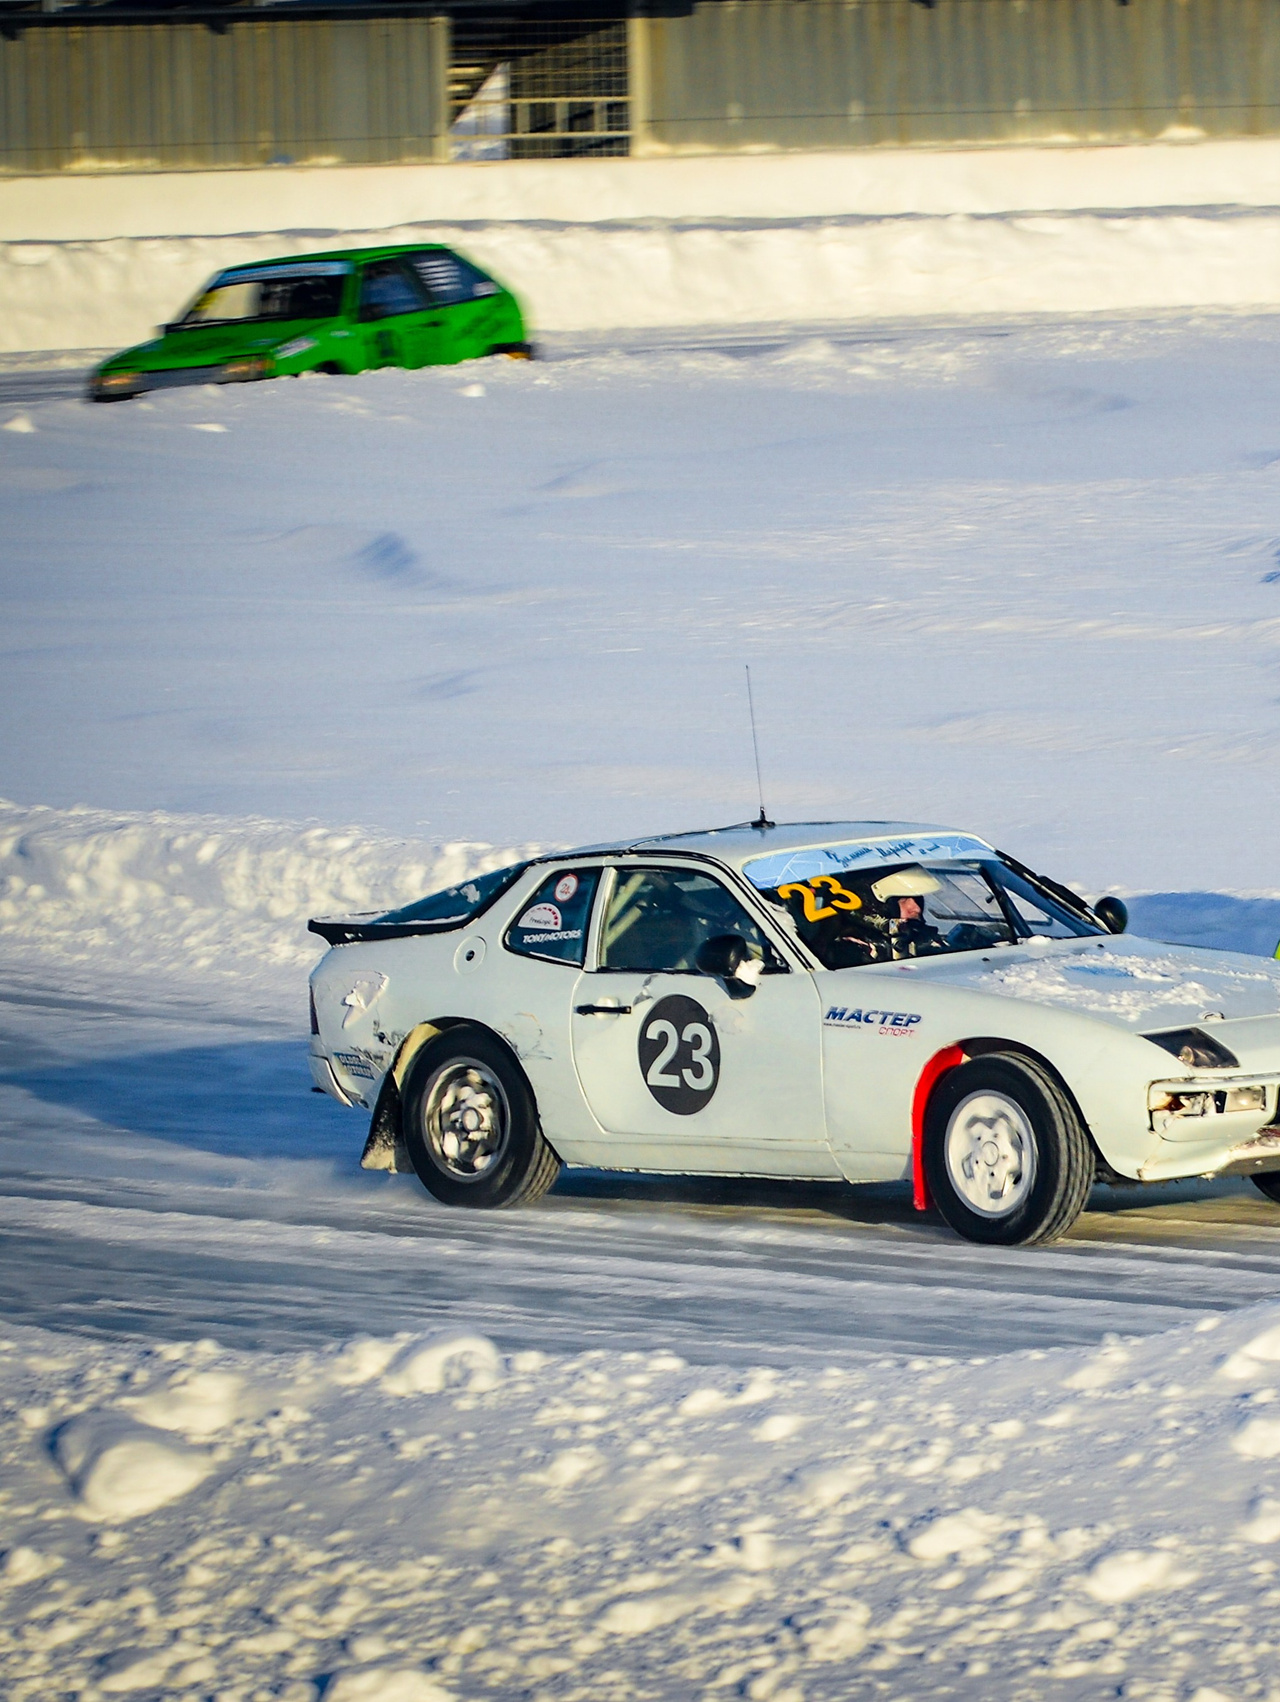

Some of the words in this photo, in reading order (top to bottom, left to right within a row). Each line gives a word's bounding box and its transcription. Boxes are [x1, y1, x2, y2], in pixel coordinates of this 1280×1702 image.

[777, 875, 863, 922] 23
[523, 929, 582, 944] TONYMOTORS
[825, 1006, 922, 1027] МАСТЕР
[879, 1026, 914, 1037] СПОРТ
[645, 1019, 714, 1091] 23
